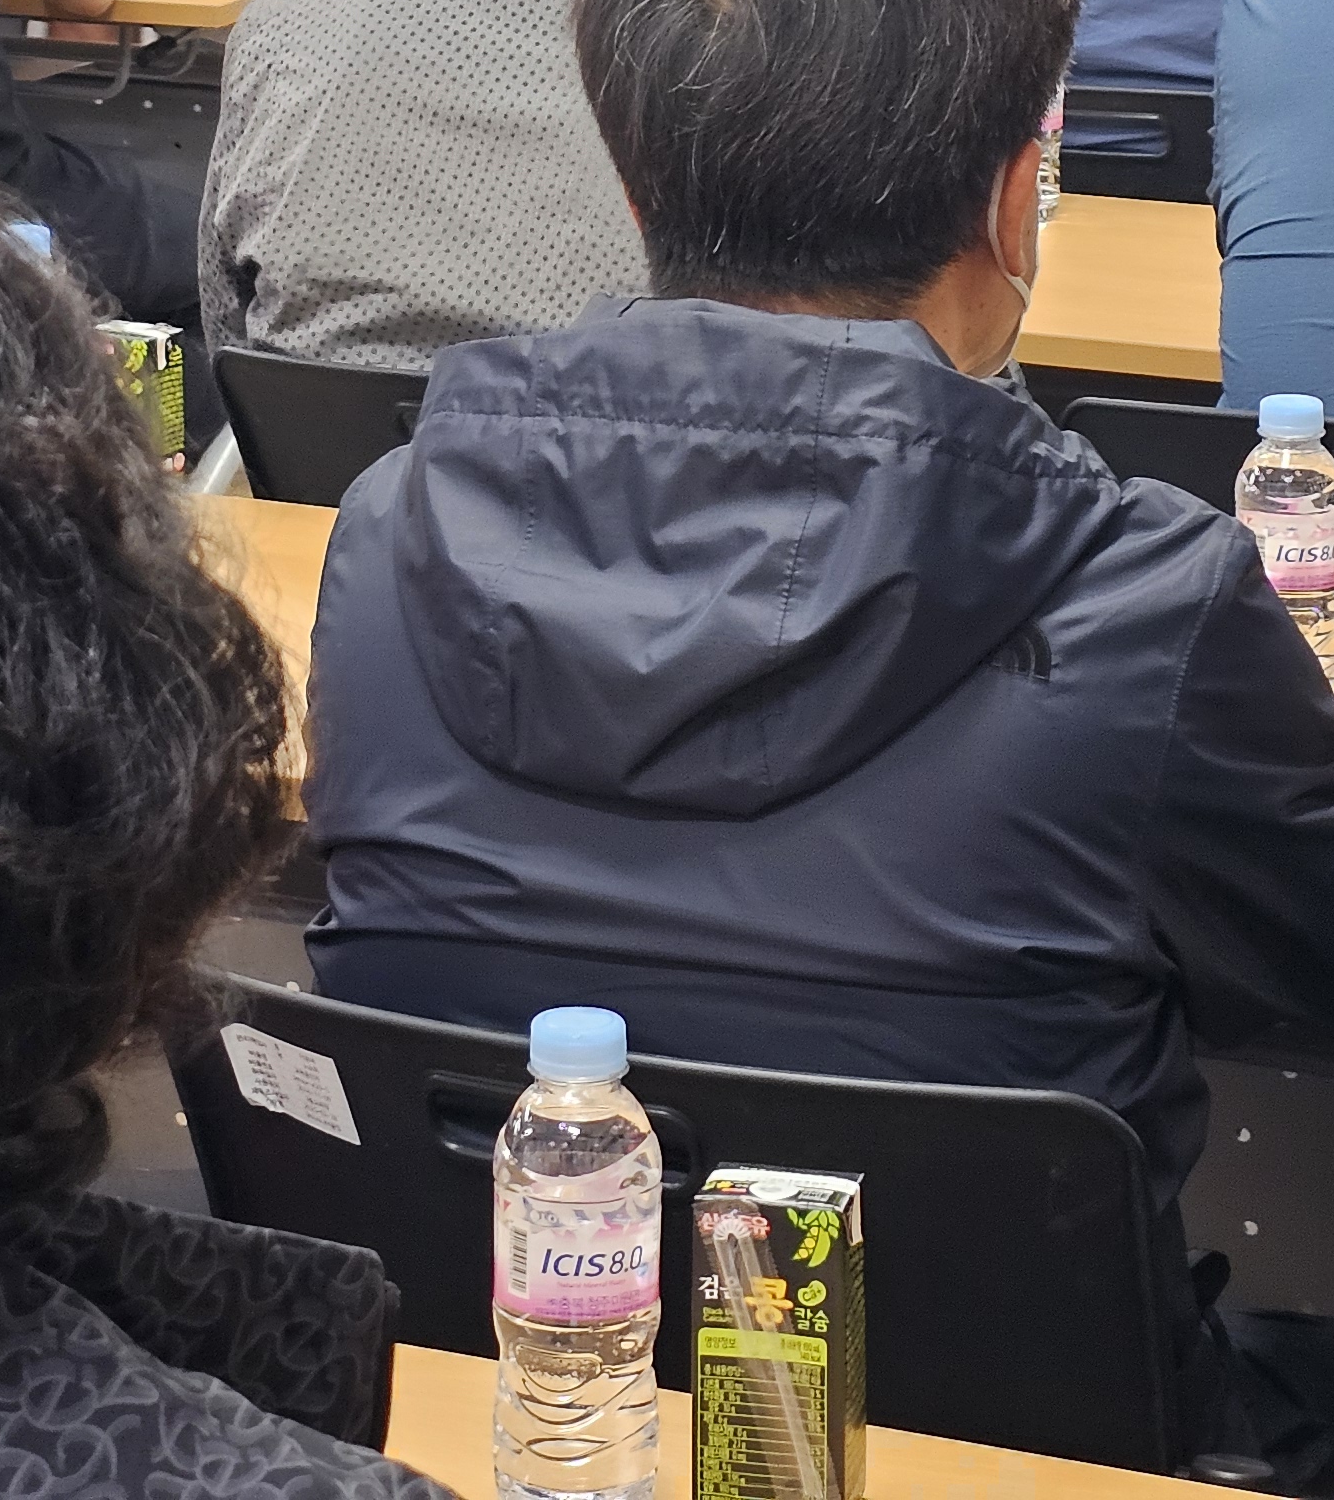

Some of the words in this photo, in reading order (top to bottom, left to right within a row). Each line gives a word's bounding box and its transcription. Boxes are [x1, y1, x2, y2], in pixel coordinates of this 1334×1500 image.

[1276, 544, 1320, 563] ICIS
[541, 1248, 607, 1277] ICIS
[609, 1245, 643, 1275] 8.0
[794, 1308, 830, 1332] 칼슘
